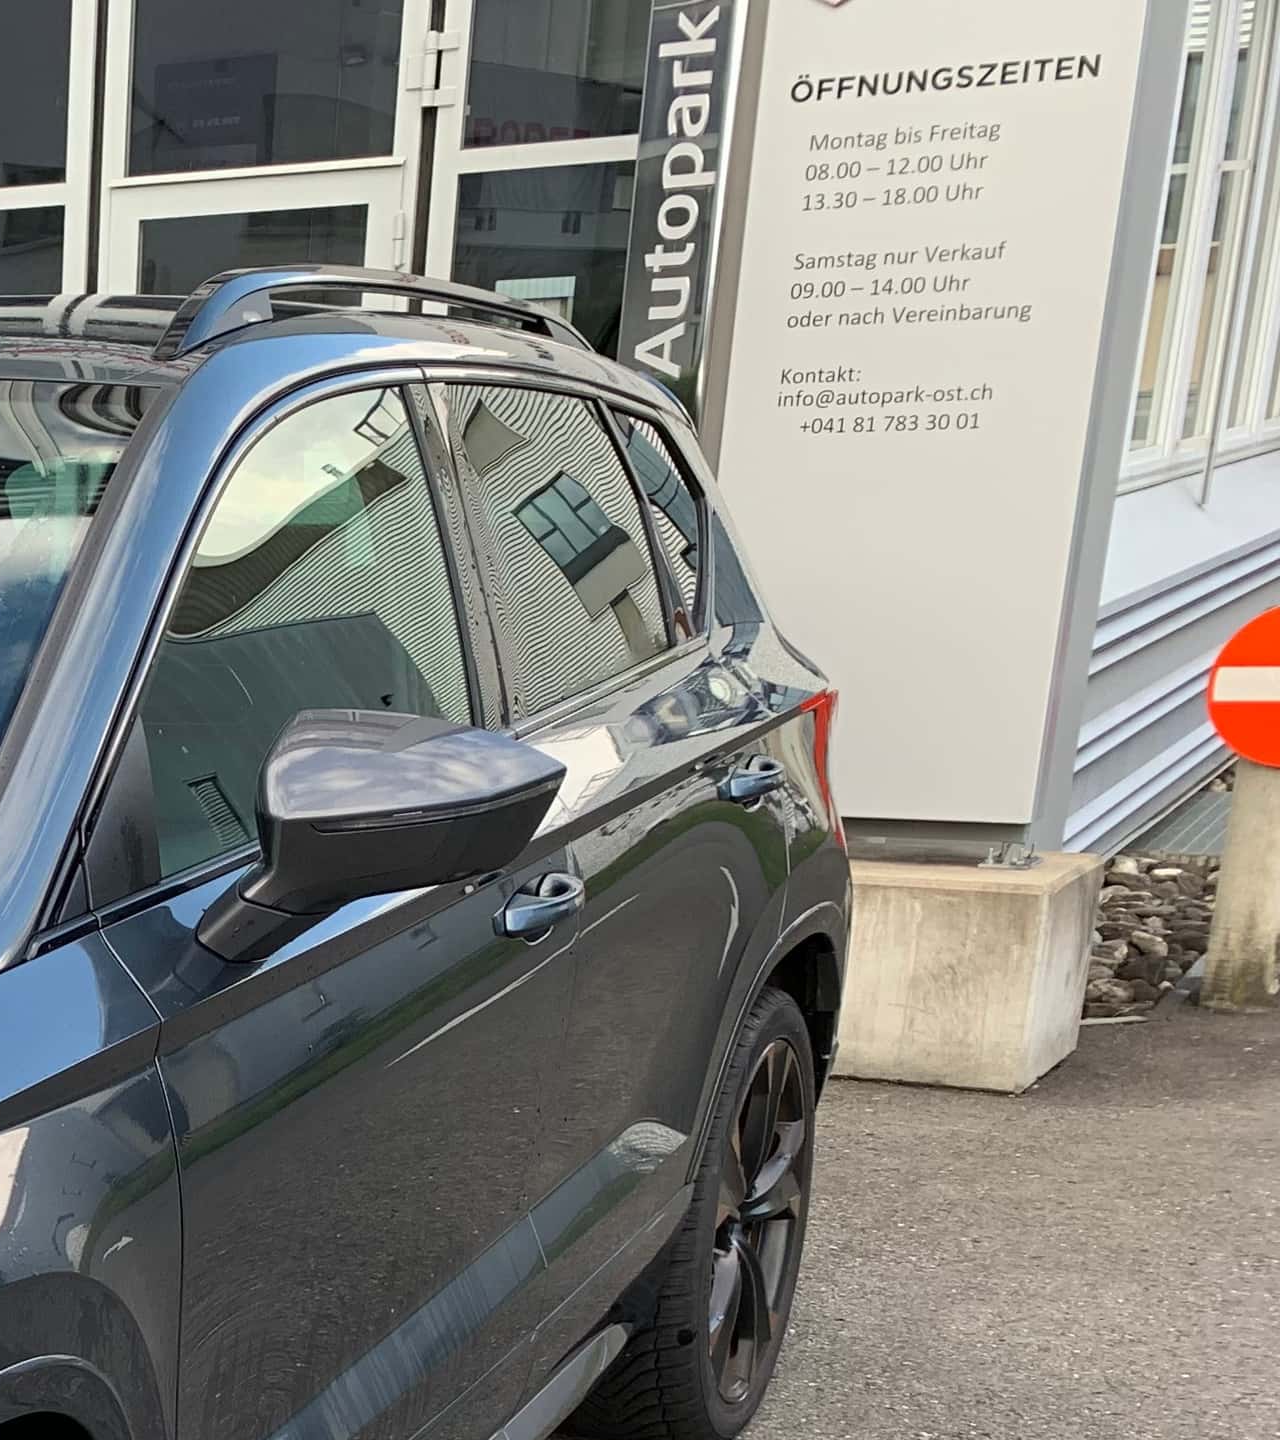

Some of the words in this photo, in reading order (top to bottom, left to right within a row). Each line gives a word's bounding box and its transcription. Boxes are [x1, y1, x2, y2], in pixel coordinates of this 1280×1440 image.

[790, 53, 1102, 104] ÖFFNUNGSZEITEN
[809, 131, 889, 153] Montag
[893, 127, 923, 145] bis
[928, 122, 1001, 143] Freitag
[804, 160, 862, 182] 08.00
[886, 154, 944, 177] 12.00
[949, 151, 989, 172] Uhr
[633, 4, 721, 380] Autopark
[801, 191, 858, 212] 13.30
[881, 184, 940, 207] 18.00
[945, 181, 985, 203] Uhr
[793, 251, 878, 271] Samstag
[883, 249, 919, 266] nur
[924, 239, 1008, 264] Verkauf
[790, 280, 846, 301] 09.00
[869, 275, 927, 297] 14.00
[932, 273, 972, 294] Uhr
[786, 309, 833, 329] oder
[837, 306, 885, 327] nach
[892, 303, 1033, 325] Vereinbarung
[780, 364, 862, 385] Kontakt:
[777, 382, 993, 409] info@autopark-ost.ch
[799, 416, 847, 435] +041
[852, 415, 876, 433] 81
[883, 414, 919, 433] 783
[924, 413, 951, 431] 30
[955, 412, 980, 431] 01
